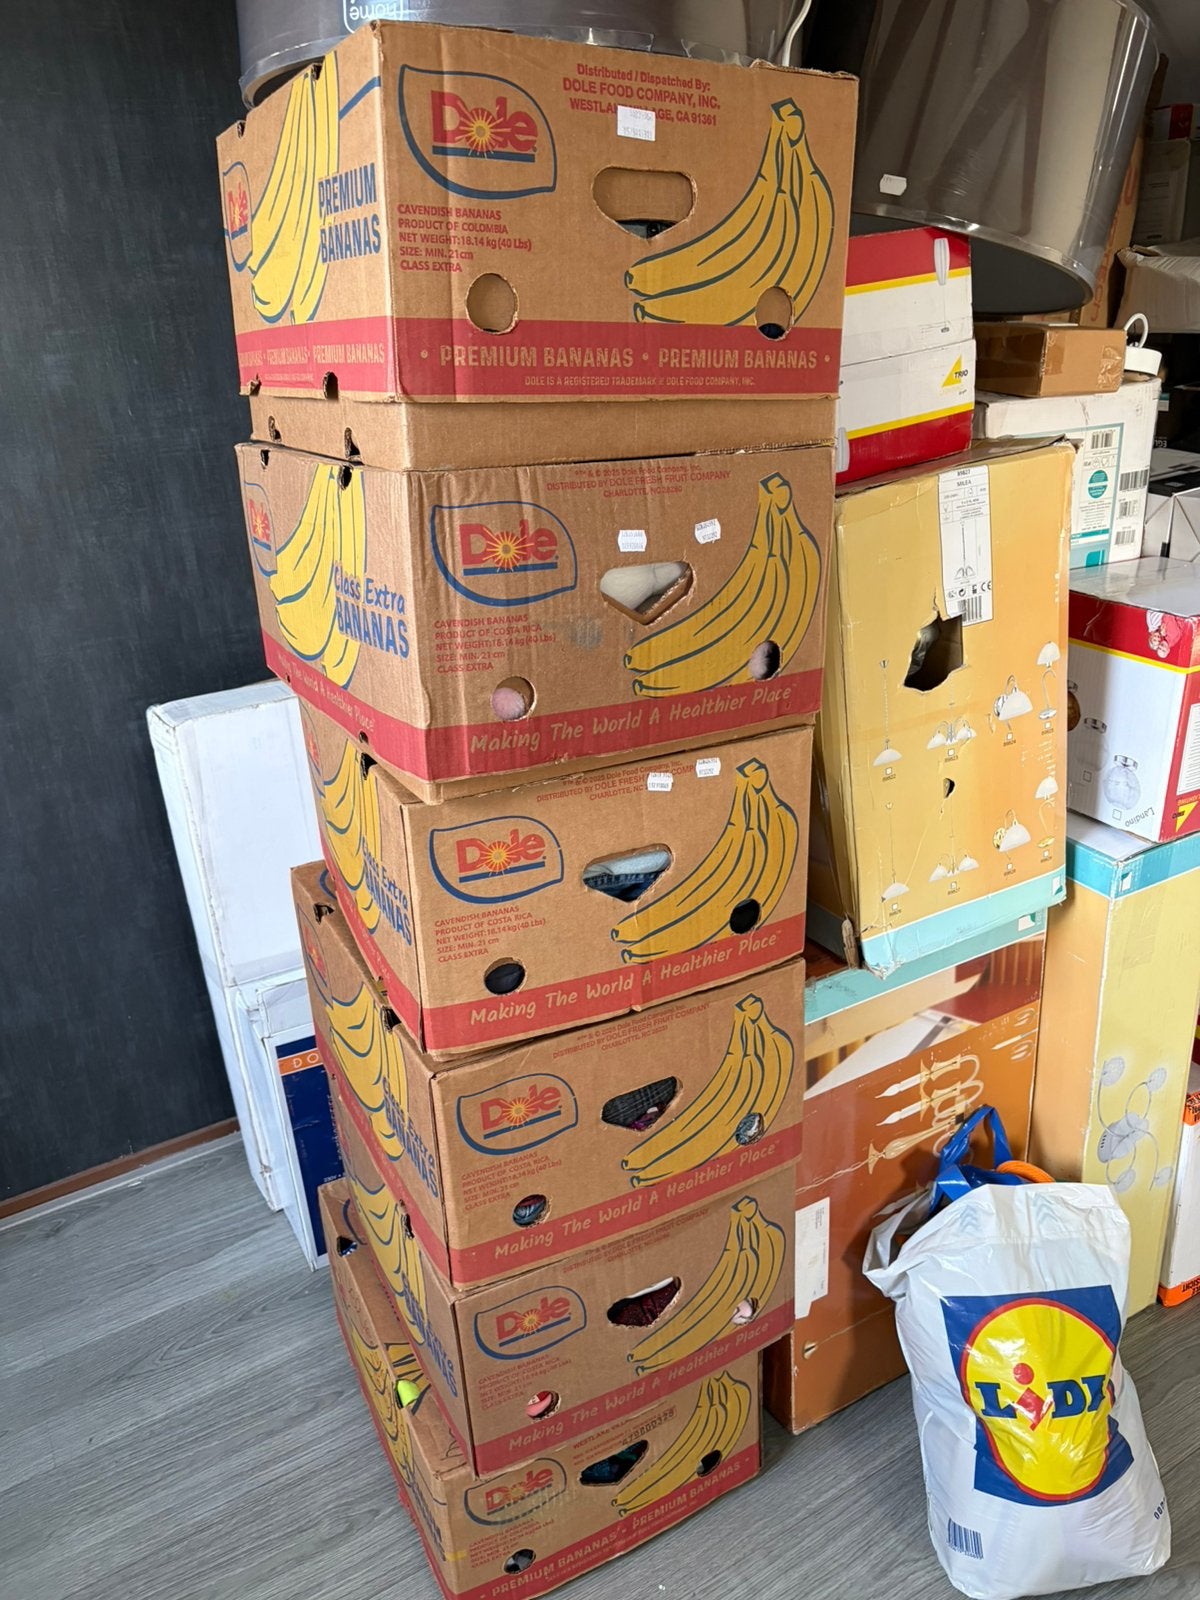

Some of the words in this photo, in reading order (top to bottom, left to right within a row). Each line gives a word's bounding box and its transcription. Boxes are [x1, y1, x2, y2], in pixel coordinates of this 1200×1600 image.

[577, 63, 633, 82] Distributed
[640, 71, 693, 89] Dispatched
[695, 79, 711, 91] By:
[563, 77, 597, 94] DOLE
[600, 82, 634, 99] FOOD
[636, 87, 696, 107] COMPANY,
[699, 95, 721, 110] INC.
[430, 91, 538, 154] Dole
[570, 98, 621, 114] WESTLA
[676, 110, 690, 123] CA
[691, 112, 717, 126] 91361
[318, 162, 377, 218] PREMIUM
[397, 204, 452, 217] CAVENDISH
[455, 207, 502, 220] BANANAS
[398, 218, 445, 230] PRODUCT
[446, 221, 459, 231] OF
[462, 222, 509, 234] COLOMBIA
[399, 232, 417, 242] NET
[319, 213, 382, 264] BANANAS
[399, 246, 423, 257] SIZE:
[425, 247, 447, 258] MIN.
[400, 260, 430, 271] CLASS
[432, 261, 463, 273] EXTRA
[313, 344, 344, 364] PREMIUM
[347, 343, 385, 364] BANANAS
[440, 346, 538, 367] PREMIUM
[543, 347, 634, 368] BANANAS
[658, 348, 739, 369] PREMIUM
[744, 350, 817, 369] BANANAS
[524, 376, 545, 386] DOLE
[547, 376, 554, 386] IS
[563, 376, 610, 386] REGISTERED
[612, 376, 656, 386] TRADEMARK
[1154, 440, 1167, 448] EGL
[547, 481, 596, 491] DISTRIBUTED
[609, 477, 633, 487] DOLE
[635, 474, 662, 485] FRESH
[665, 473, 687, 483] FRUIT
[690, 470, 731, 481] COMPANY
[459, 518, 558, 568] Dole
[334, 563, 362, 600] Class
[365, 578, 406, 616] Extra
[335, 597, 410, 659] BANANAS
[434, 617, 486, 629] CAVENDISH
[487, 614, 529, 625] BANANAS
[435, 629, 476, 640] PRODUCT
[478, 629, 490, 637] OF
[493, 626, 520, 636] COSTA
[522, 624, 542, 633] RICA
[436, 653, 457, 663] SIZE:
[437, 664, 463, 674] CLASS
[466, 662, 493, 672] EXTRA
[471, 729, 541, 754] Making
[551, 722, 583, 741] The
[592, 711, 640, 735] World
[649, 708, 661, 724] A
[670, 696, 745, 723] Healthier
[607, 771, 621, 781] Dole
[537, 788, 583, 803] DISTRIBUTED
[584, 786, 593, 795] BY
[595, 780, 617, 791] DOLE
[619, 774, 646, 788] FRESH
[633, 784, 644, 793] NC
[1125, 807, 1155, 828] Landino
[456, 828, 546, 874] Dole
[363, 860, 412, 946] BANANAS
[435, 912, 480, 928] CAVENDISH
[481, 905, 520, 919] BANANAS
[435, 924, 472, 936] PRODUCT
[474, 921, 484, 929] OF
[487, 917, 512, 926] COSTA
[514, 912, 533, 921] RICA
[436, 937, 451, 945] NET
[437, 945, 456, 954] SIZE:
[438, 953, 461, 963] CLASS
[464, 948, 489, 958] EXTRA
[470, 1002, 536, 1026] Making
[545, 988, 577, 1009] The
[586, 973, 634, 997] World
[642, 970, 652, 986] A
[661, 947, 732, 979] Healthier
[606, 1031, 628, 1043] DOLE
[628, 1022, 652, 1035] FRESH
[653, 1015, 674, 1027] FRUIT
[675, 1003, 711, 1021] COMPANY
[480, 1084, 562, 1131] Dole
[494, 1231, 554, 1259] Making
[562, 1216, 592, 1237] The
[599, 1198, 641, 1223] World
[649, 1191, 659, 1205] A
[667, 1163, 732, 1198] Healthier
[496, 1296, 571, 1340] Dole
[508, 1421, 563, 1450] Making
[571, 1405, 599, 1425] The
[605, 1384, 645, 1410] World
[651, 1377, 661, 1390] A
[667, 1344, 729, 1381] Healthier
[485, 1469, 553, 1512] Dole
[492, 1563, 555, 1597] PREMIUM
[558, 1532, 617, 1569] BANANAS
[632, 1496, 688, 1530] PREMIUM
[690, 1461, 741, 1498] BANANAS
